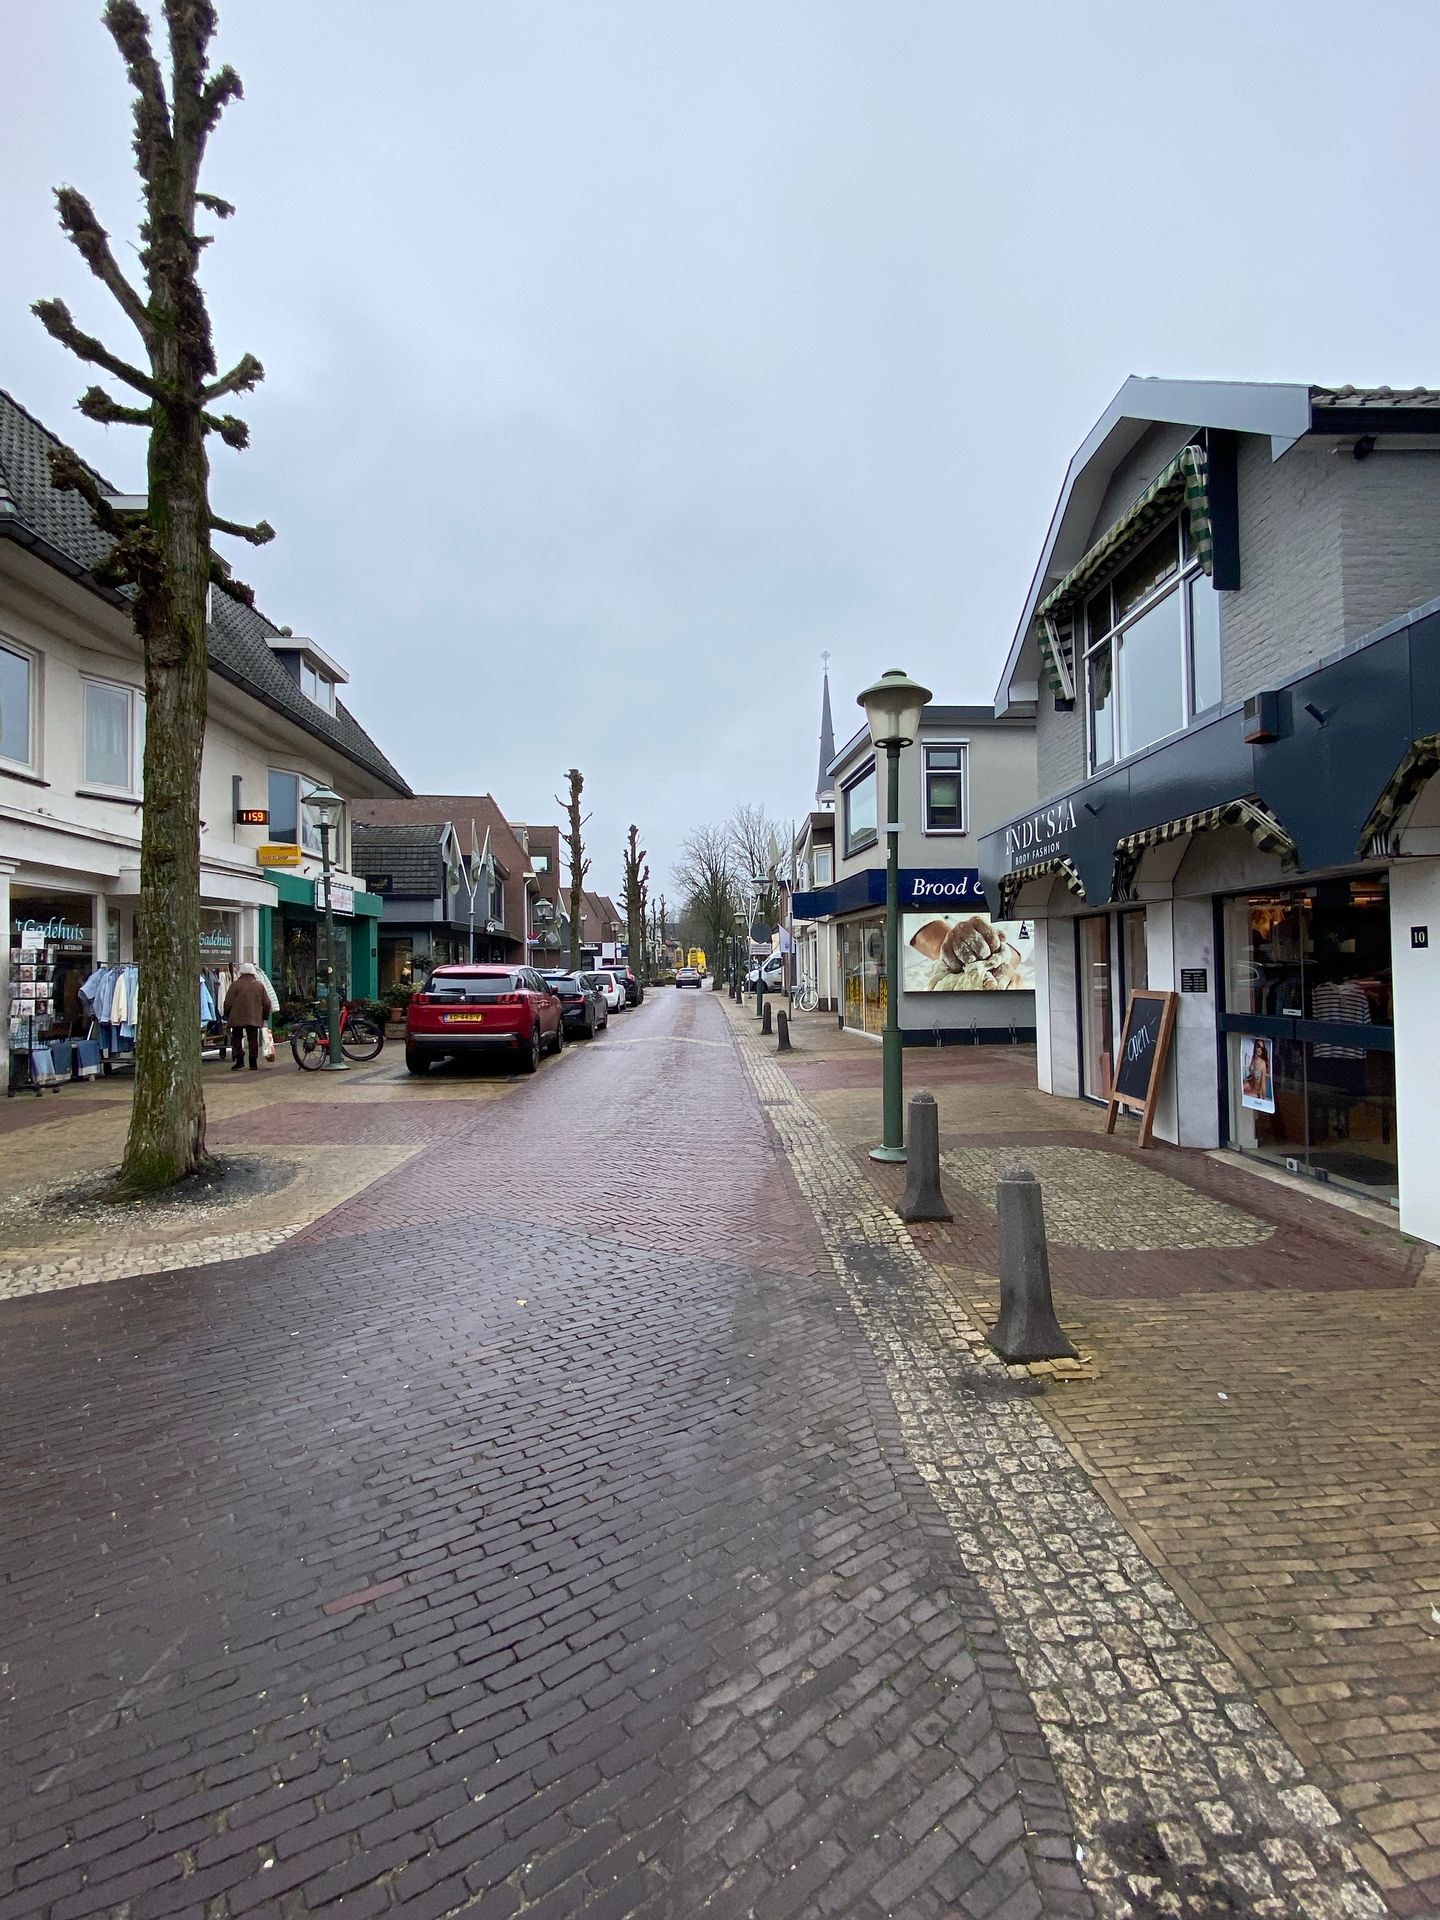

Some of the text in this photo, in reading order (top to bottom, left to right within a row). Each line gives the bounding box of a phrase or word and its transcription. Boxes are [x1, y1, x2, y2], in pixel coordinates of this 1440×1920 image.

[1005, 800, 1077, 856] INDUSIA
[1015, 841, 1060, 866] BODY FASHION
[911, 876, 968, 896] Brood
[1414, 931, 1425, 943] 10
